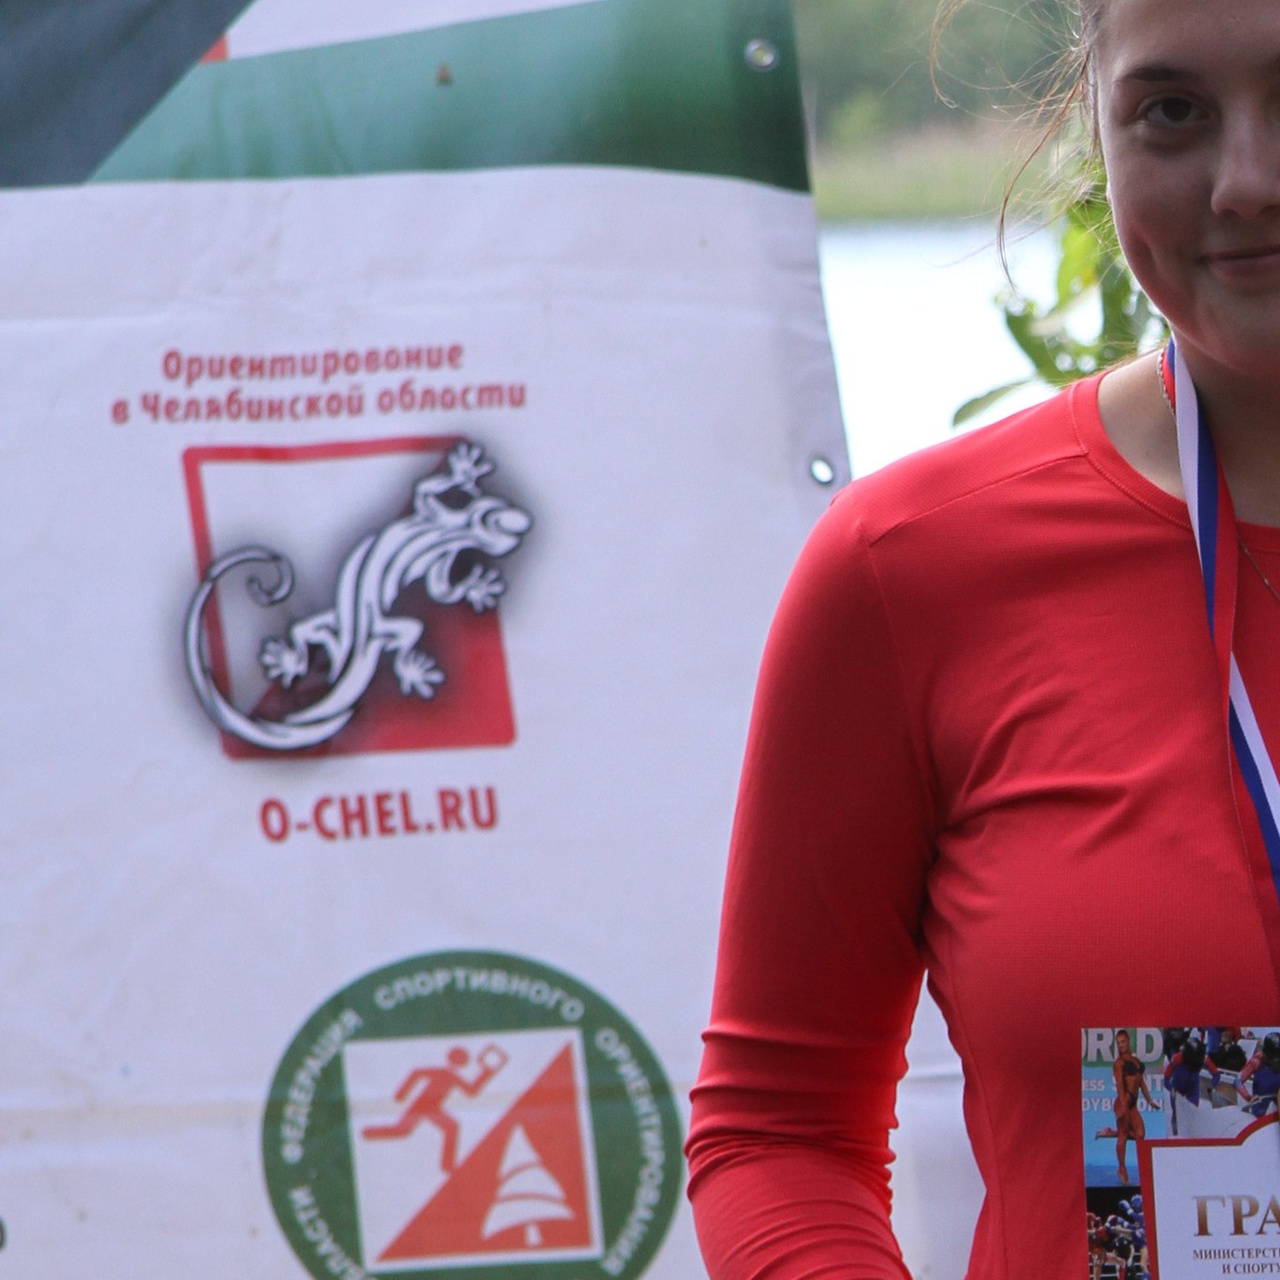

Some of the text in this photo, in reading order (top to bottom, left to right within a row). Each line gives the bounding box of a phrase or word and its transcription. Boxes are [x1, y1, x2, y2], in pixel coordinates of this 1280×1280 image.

[163, 343, 463, 388] Ориентирование
[112, 381, 526, 423] в Челябинской области
[259, 787, 498, 843] O-CHEL.RU
[280, 1007, 364, 1164] ФЕДЕРАЦИЯ
[374, 967, 585, 1022] СПОРТИВНОГО
[594, 1026, 666, 1276] ОРИЕНТИРОВАНИЯ
[1222, 1263, 1231, 1274] И
